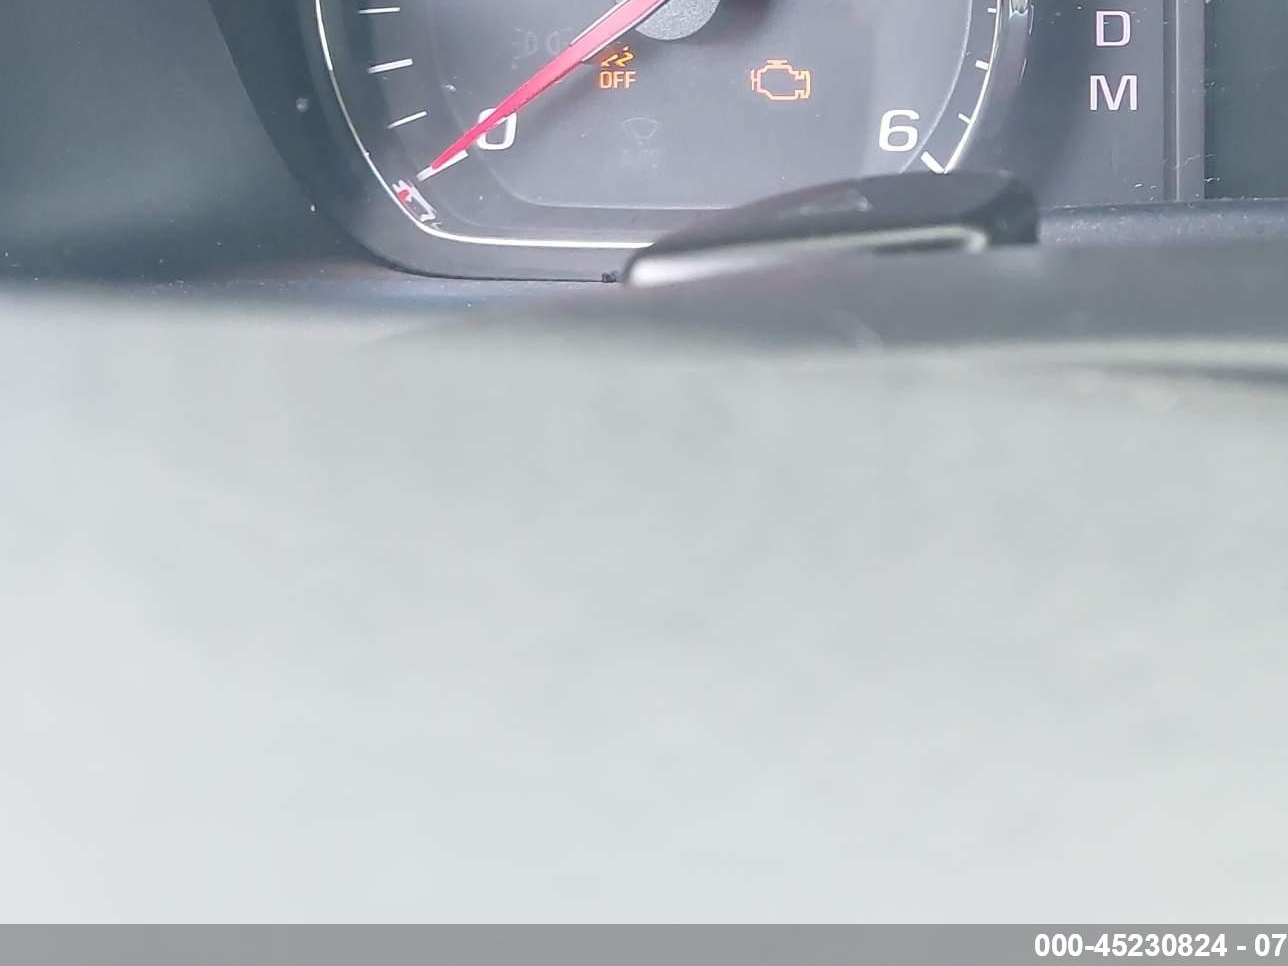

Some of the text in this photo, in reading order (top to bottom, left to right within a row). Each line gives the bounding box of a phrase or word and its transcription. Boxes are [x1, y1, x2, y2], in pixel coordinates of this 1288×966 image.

[1095, 10, 1132, 47] D
[598, 68, 636, 89] OFF
[1088, 75, 1139, 112] M
[475, 108, 517, 151] 0
[878, 109, 920, 152] 6
